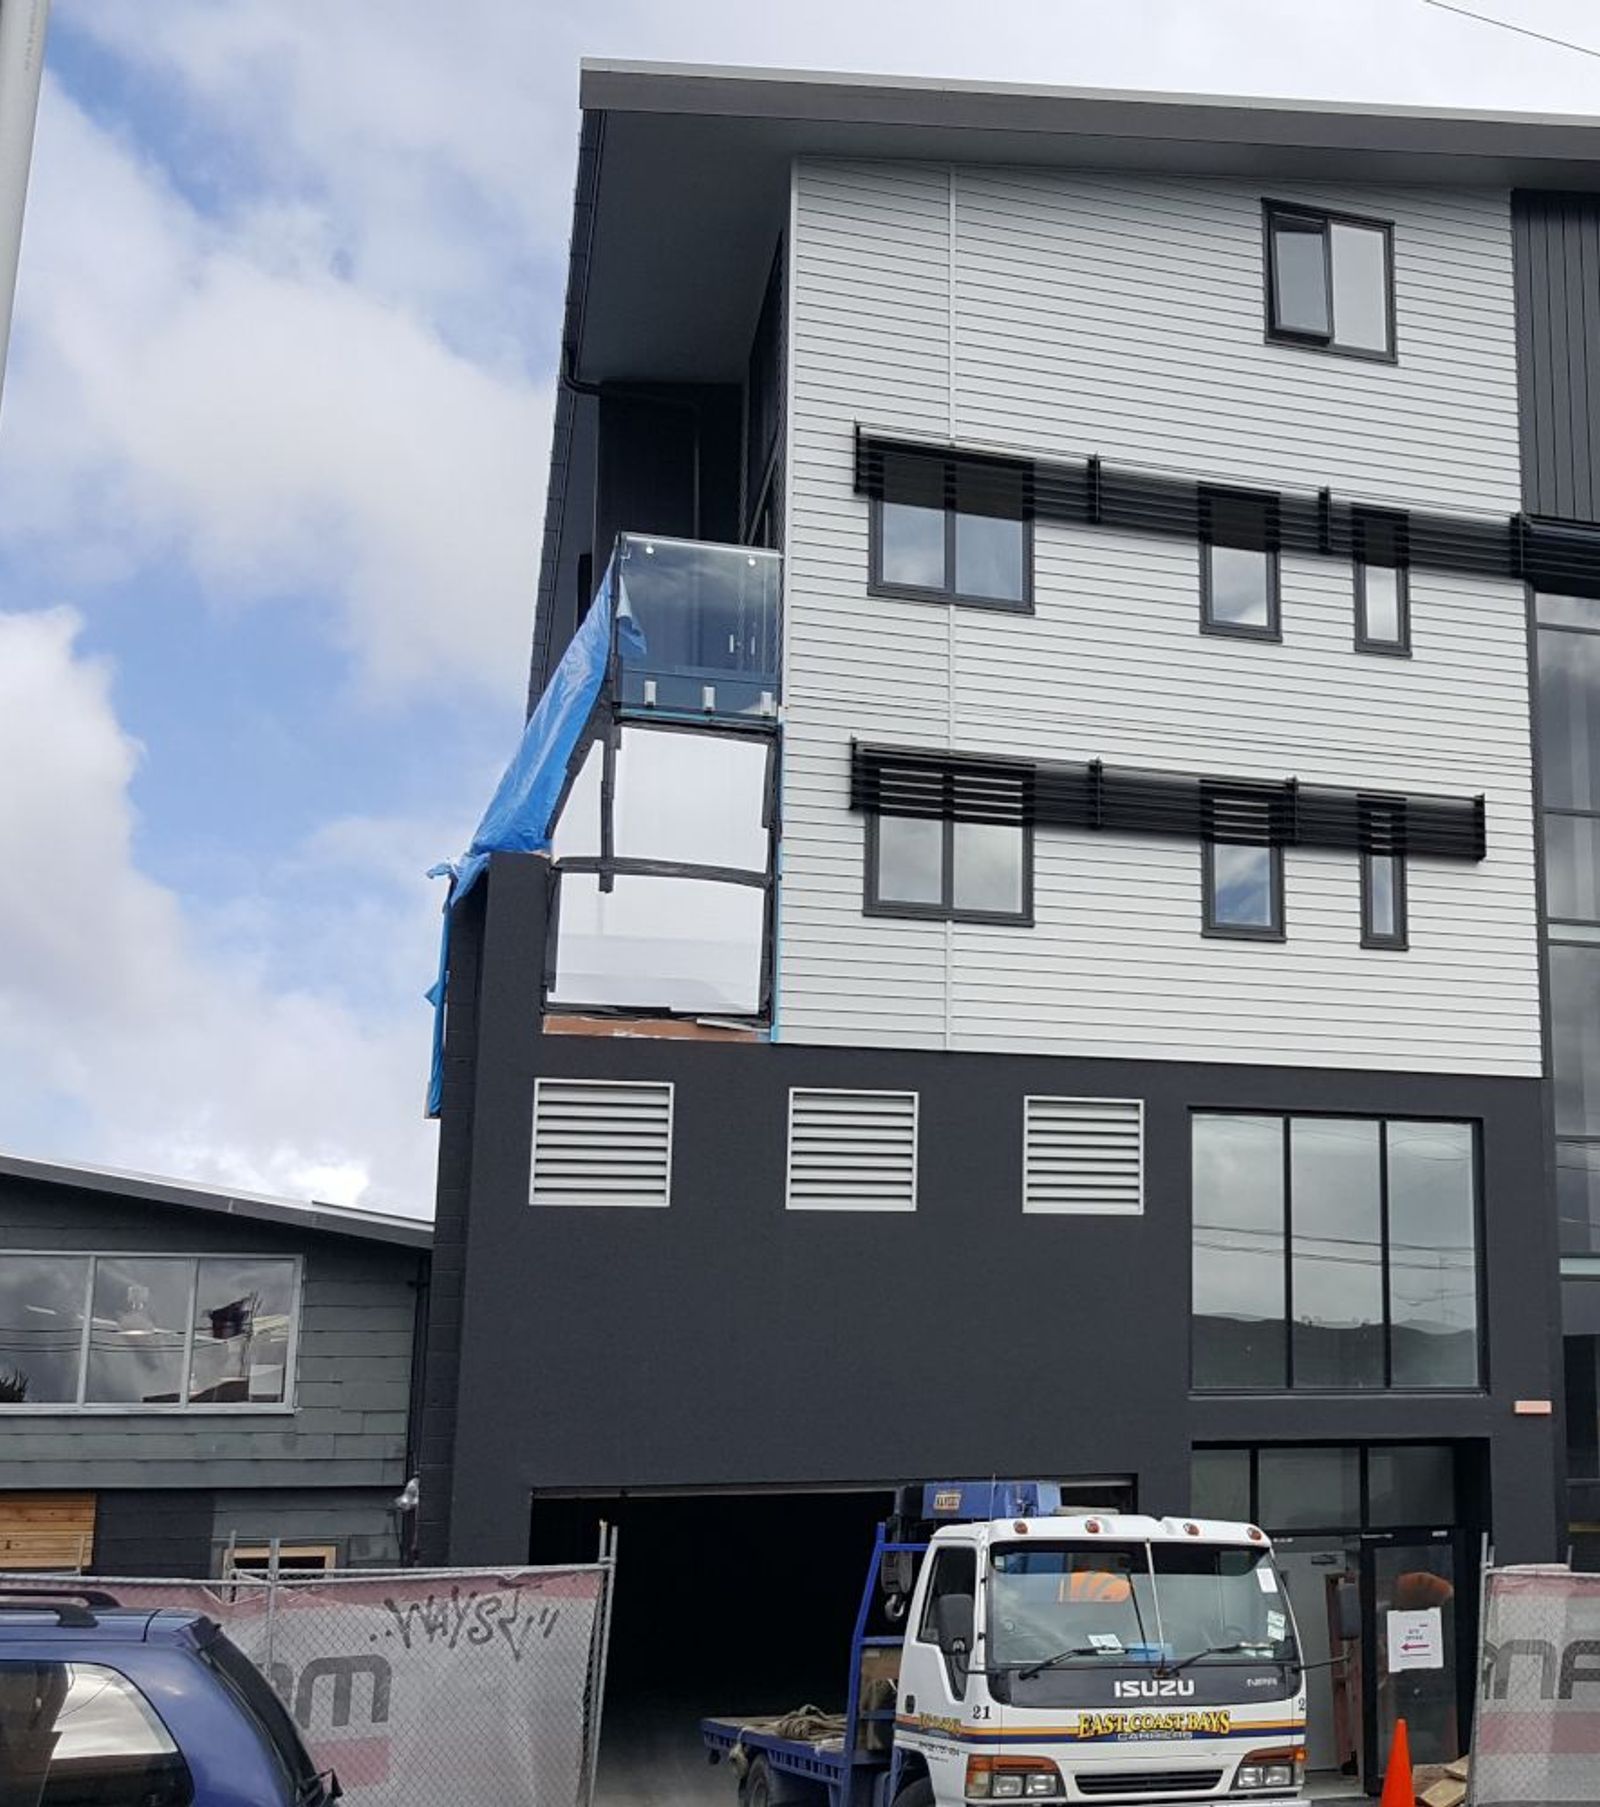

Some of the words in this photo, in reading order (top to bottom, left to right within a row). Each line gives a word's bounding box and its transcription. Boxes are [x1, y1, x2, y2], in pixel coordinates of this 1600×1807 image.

[1114, 1679, 1196, 1698] ISUZU
[972, 1704, 992, 1720] 21
[1078, 1712, 1128, 1739] EAST
[1128, 1711, 1186, 1733] COAST
[1186, 1709, 1231, 1735] BAYS
